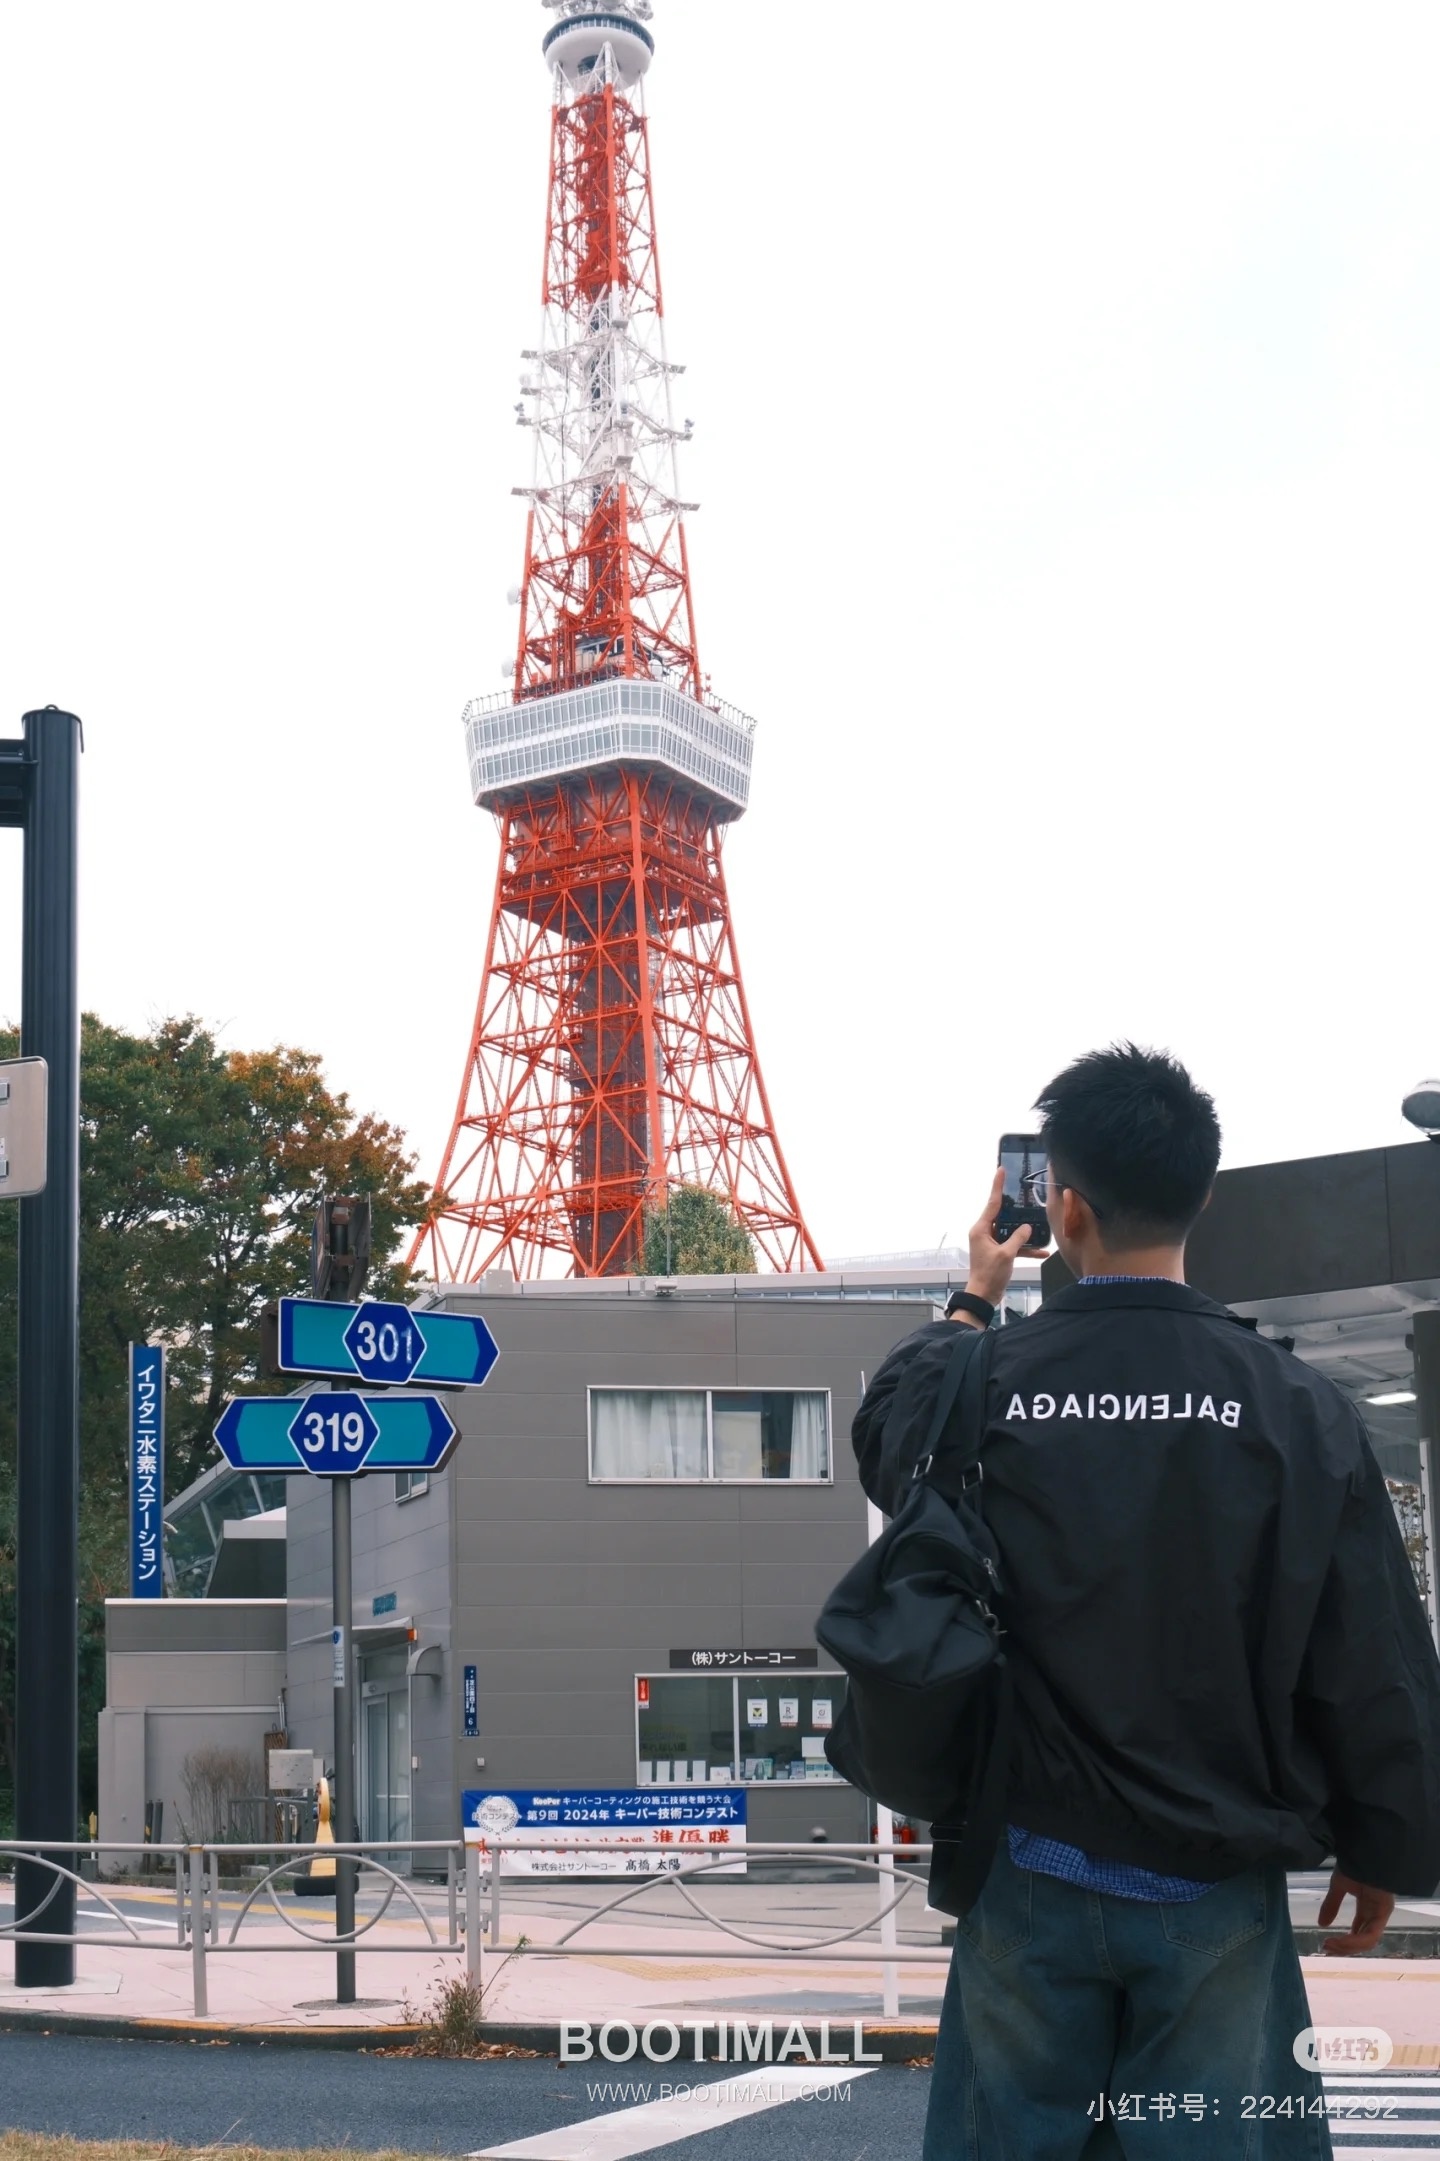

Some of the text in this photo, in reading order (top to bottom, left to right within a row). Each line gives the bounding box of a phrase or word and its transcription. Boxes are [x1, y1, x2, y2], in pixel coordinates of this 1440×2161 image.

[356, 1320, 413, 1364] 301
[303, 1411, 365, 1453] 319
[136, 1364, 158, 1580] イワタニ水素ステーション
[691, 1651, 796, 1666] (株)サントーコー
[527, 1809, 558, 1821] 第9回
[563, 1808, 610, 1821] 2024年
[531, 1863, 617, 1872] 株式会社サントーコー
[656, 1858, 681, 1871] 太陽
